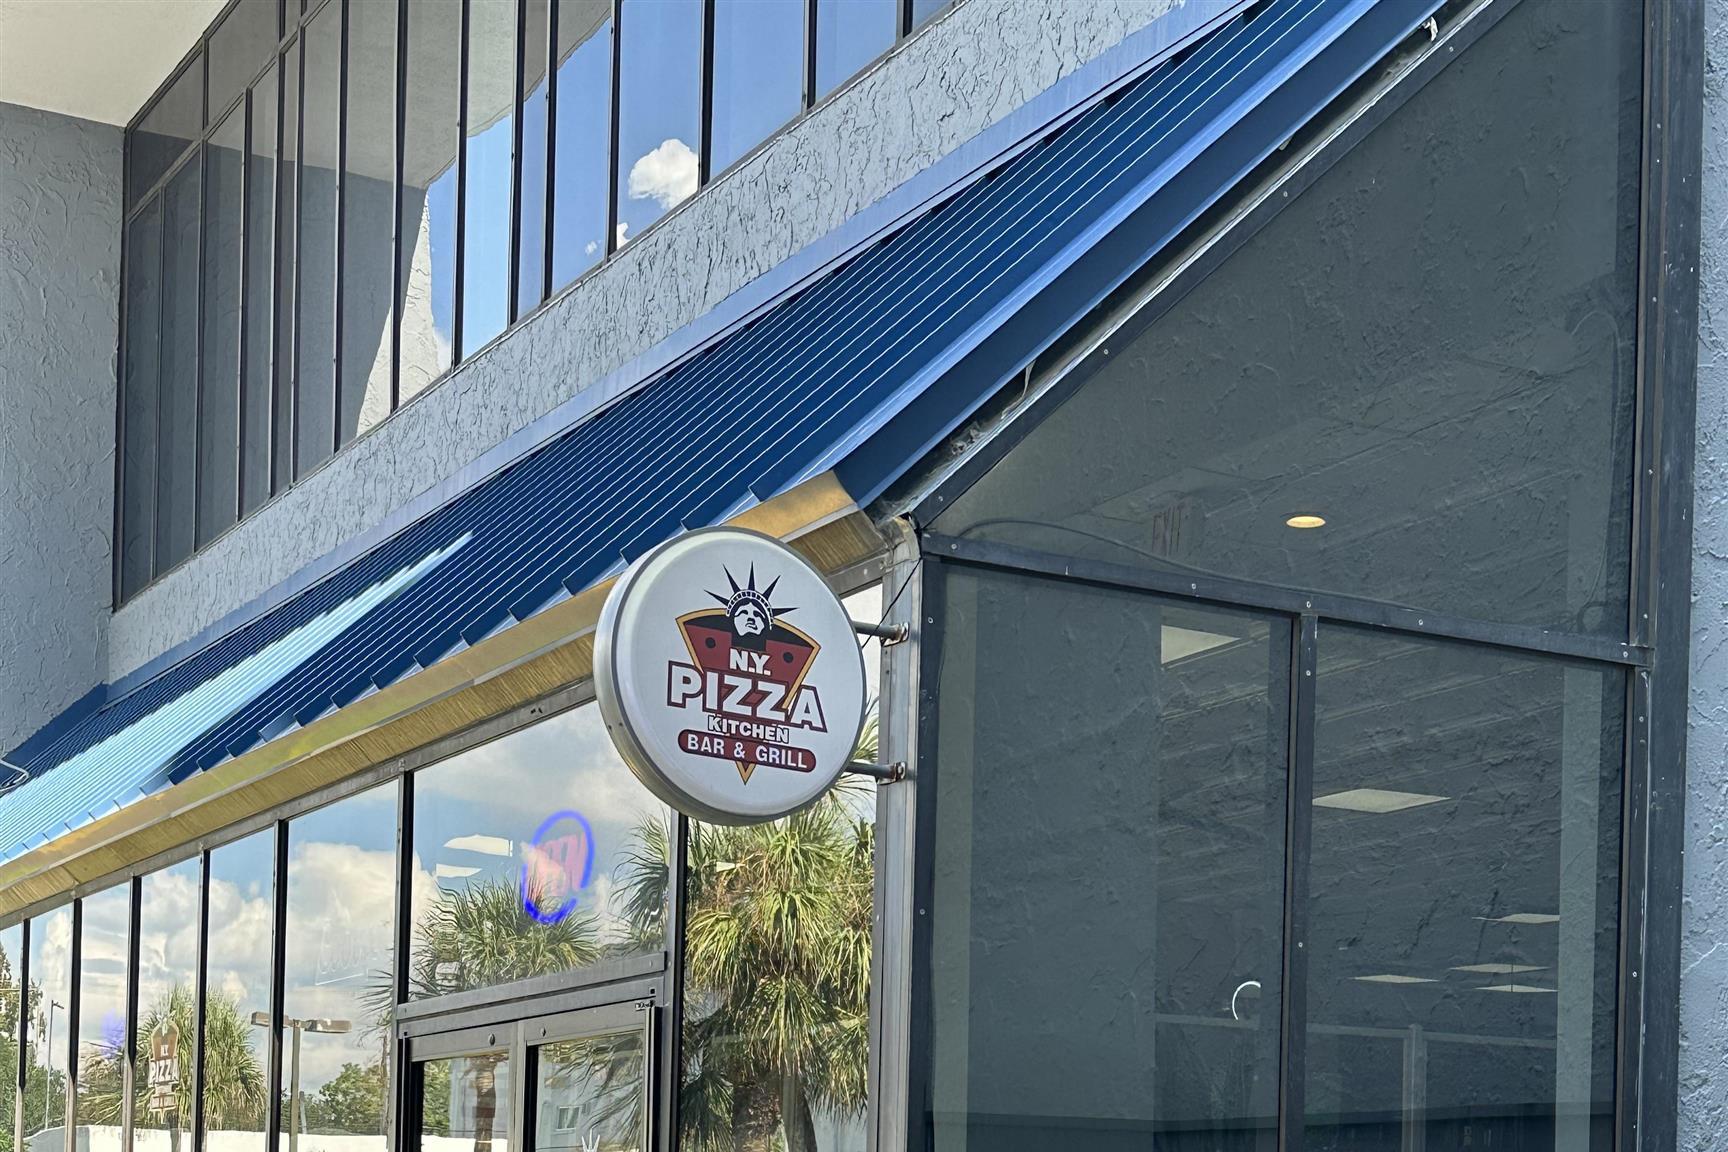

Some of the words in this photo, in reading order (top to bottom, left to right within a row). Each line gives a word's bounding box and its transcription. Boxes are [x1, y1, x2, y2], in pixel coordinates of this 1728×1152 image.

[729, 648, 772, 676] N.Y.
[667, 661, 828, 733] PIZZA
[708, 715, 790, 744] KITCHEN
[687, 734, 725, 756] BAR
[733, 742, 746, 759] &
[756, 746, 808, 769] GRILL
